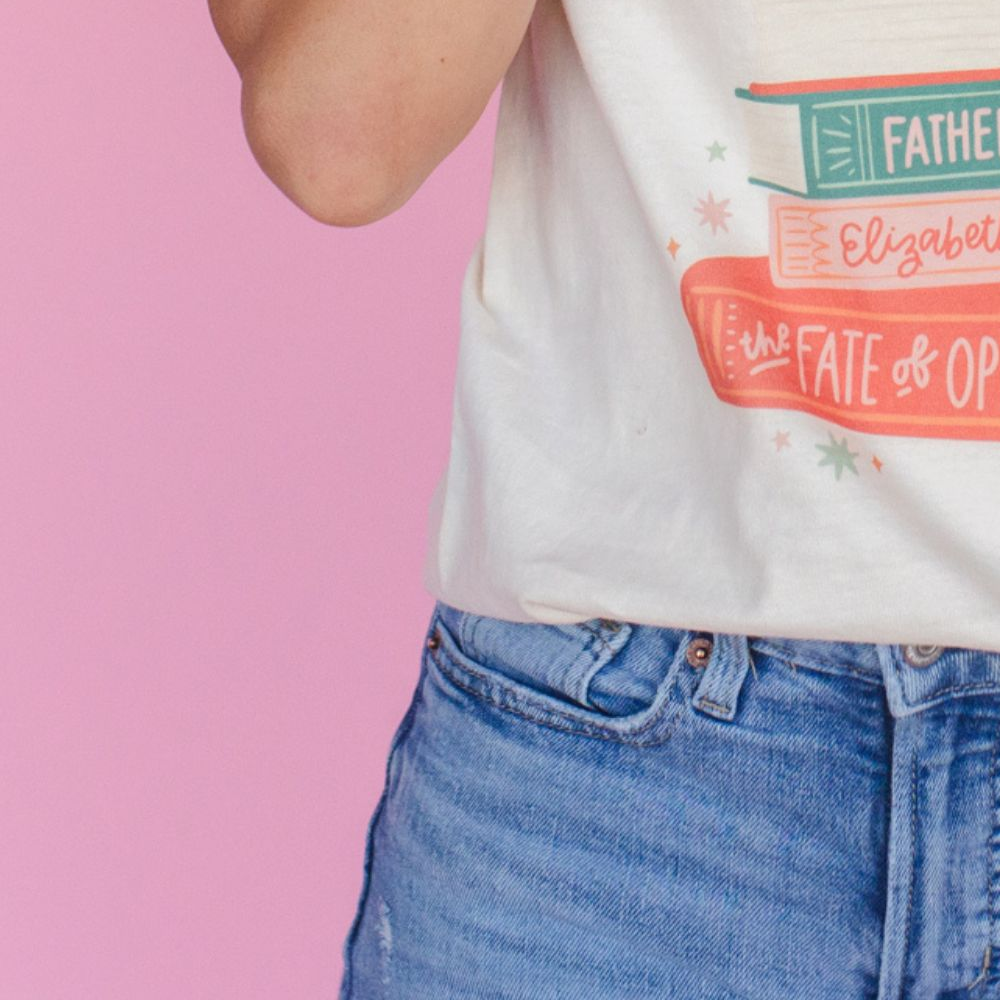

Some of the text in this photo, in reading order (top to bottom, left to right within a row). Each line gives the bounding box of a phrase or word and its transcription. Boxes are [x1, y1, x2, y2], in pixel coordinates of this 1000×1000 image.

[740, 322, 790, 375] the
[797, 325, 883, 406] FATE
[892, 333, 938, 398] of
